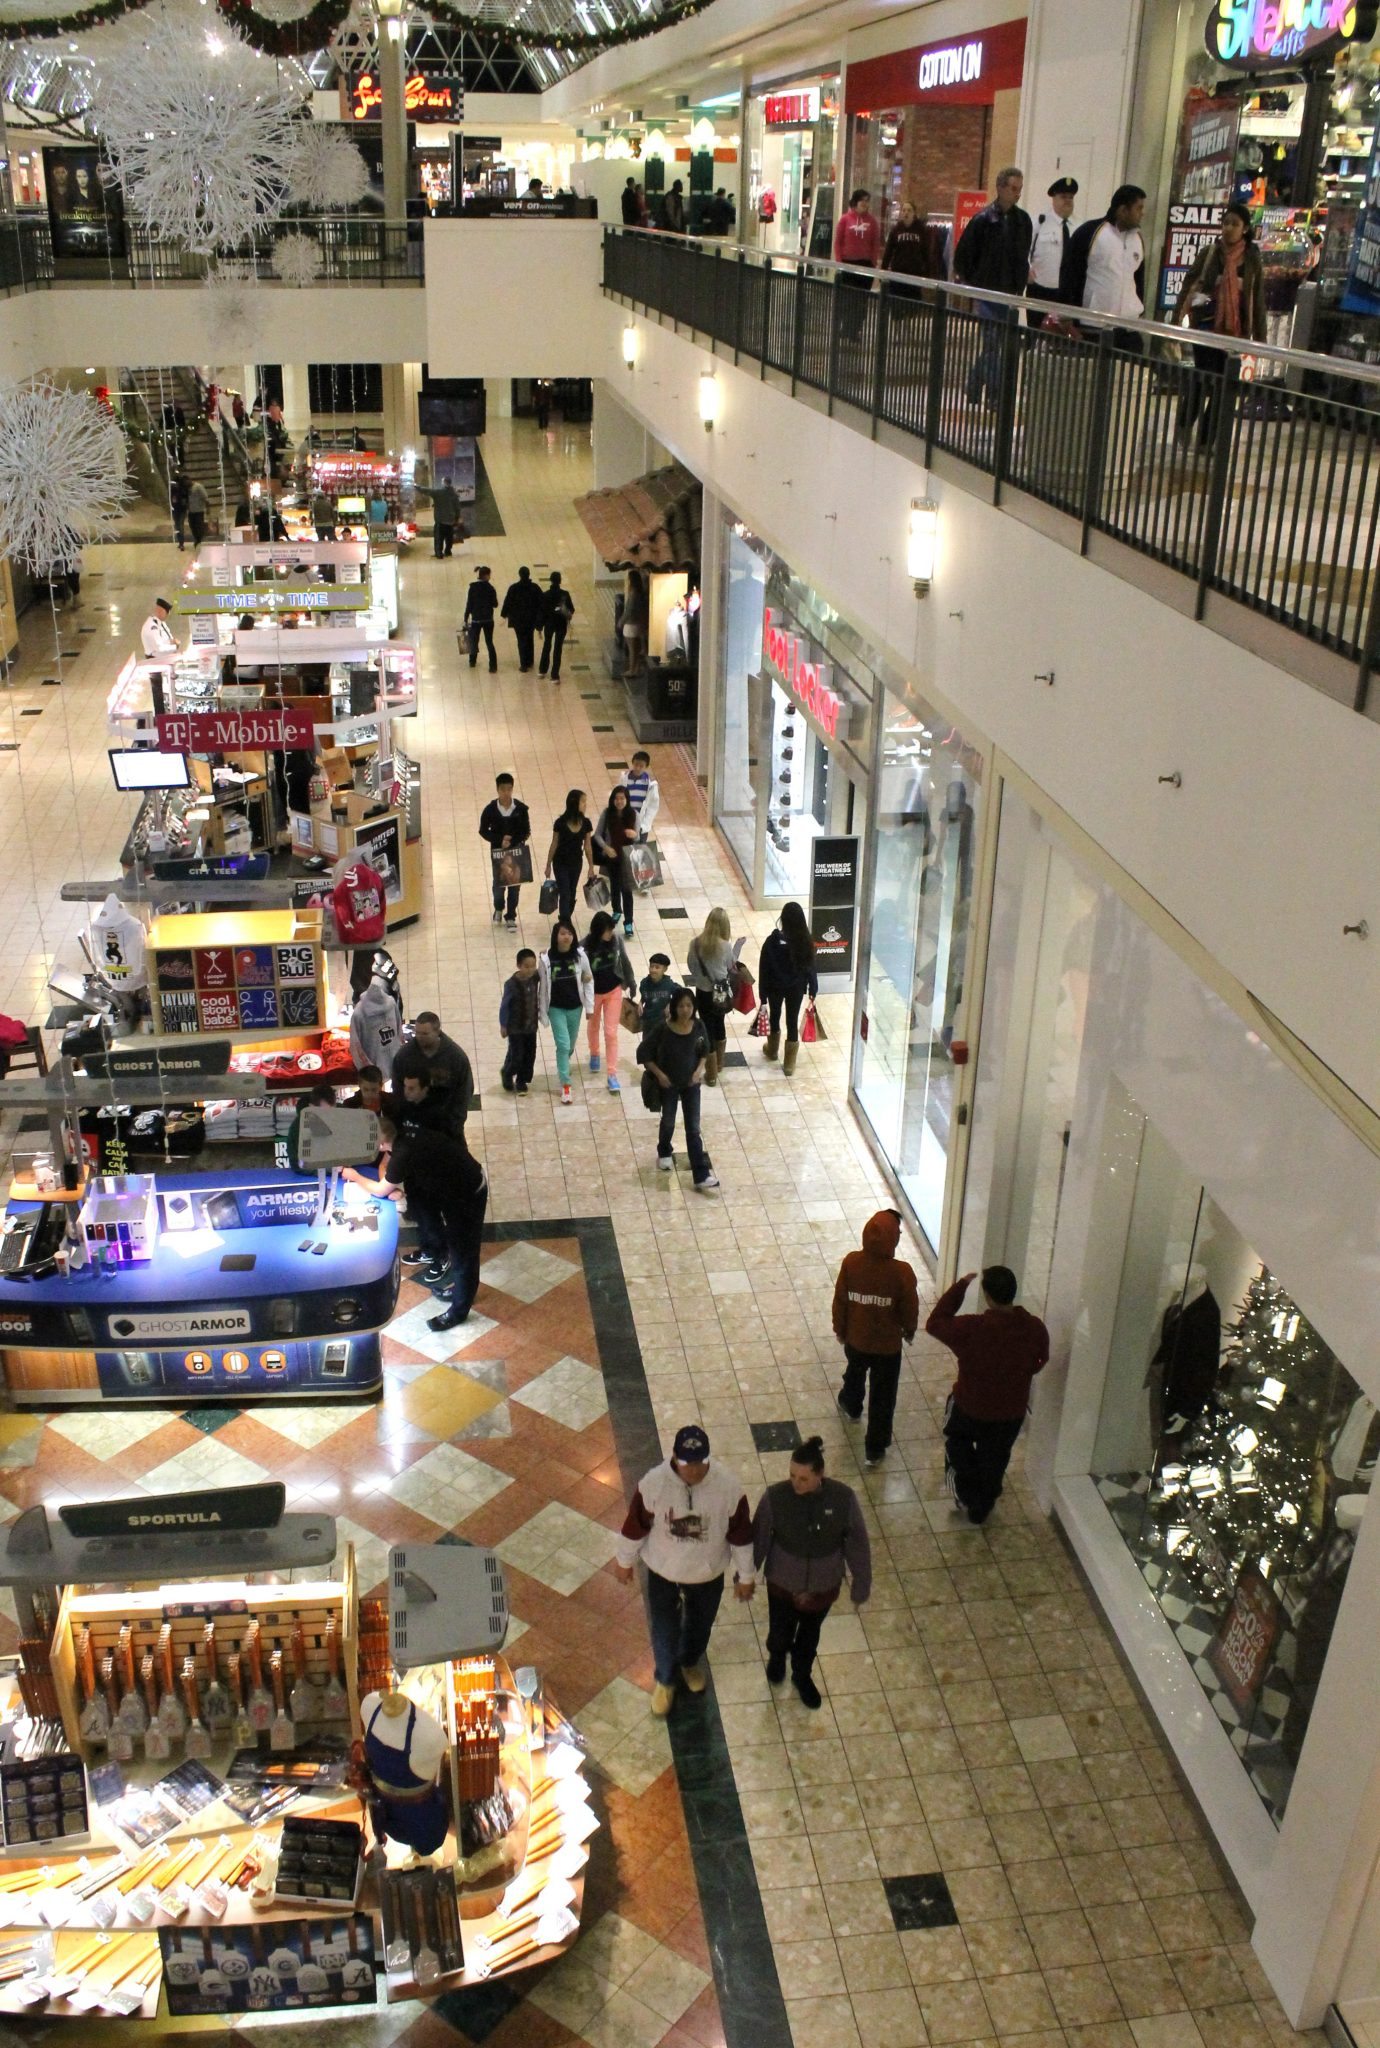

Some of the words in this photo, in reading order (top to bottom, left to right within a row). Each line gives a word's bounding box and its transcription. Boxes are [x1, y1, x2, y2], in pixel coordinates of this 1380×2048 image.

[1270, 29, 1307, 60] gifts
[919, 48, 962, 90] COTTON
[962, 41, 983, 82] ON
[353, 76, 382, 118] foo
[1172, 233, 1191, 245] BUY
[216, 593, 257, 608] TIME
[287, 592, 329, 606] TIME
[277, 947, 313, 963] BIG
[278, 962, 315, 977] BLUE
[201, 995, 230, 1006] cool
[202, 1005, 237, 1016] story.
[180, 1021, 198, 1033] DIE
[203, 1015, 236, 1025] babe.
[113, 1062, 154, 1071] GHOST
[159, 1060, 201, 1069] ARMOR
[105, 1149, 128, 1157] CALM
[246, 1190, 320, 1207] ARMOR
[250, 1208, 276, 1220] your
[279, 1203, 320, 1216] lifestyle
[847, 1291, 892, 1307] VOLUNTEER
[128, 1511, 222, 1526] SPORTULA
